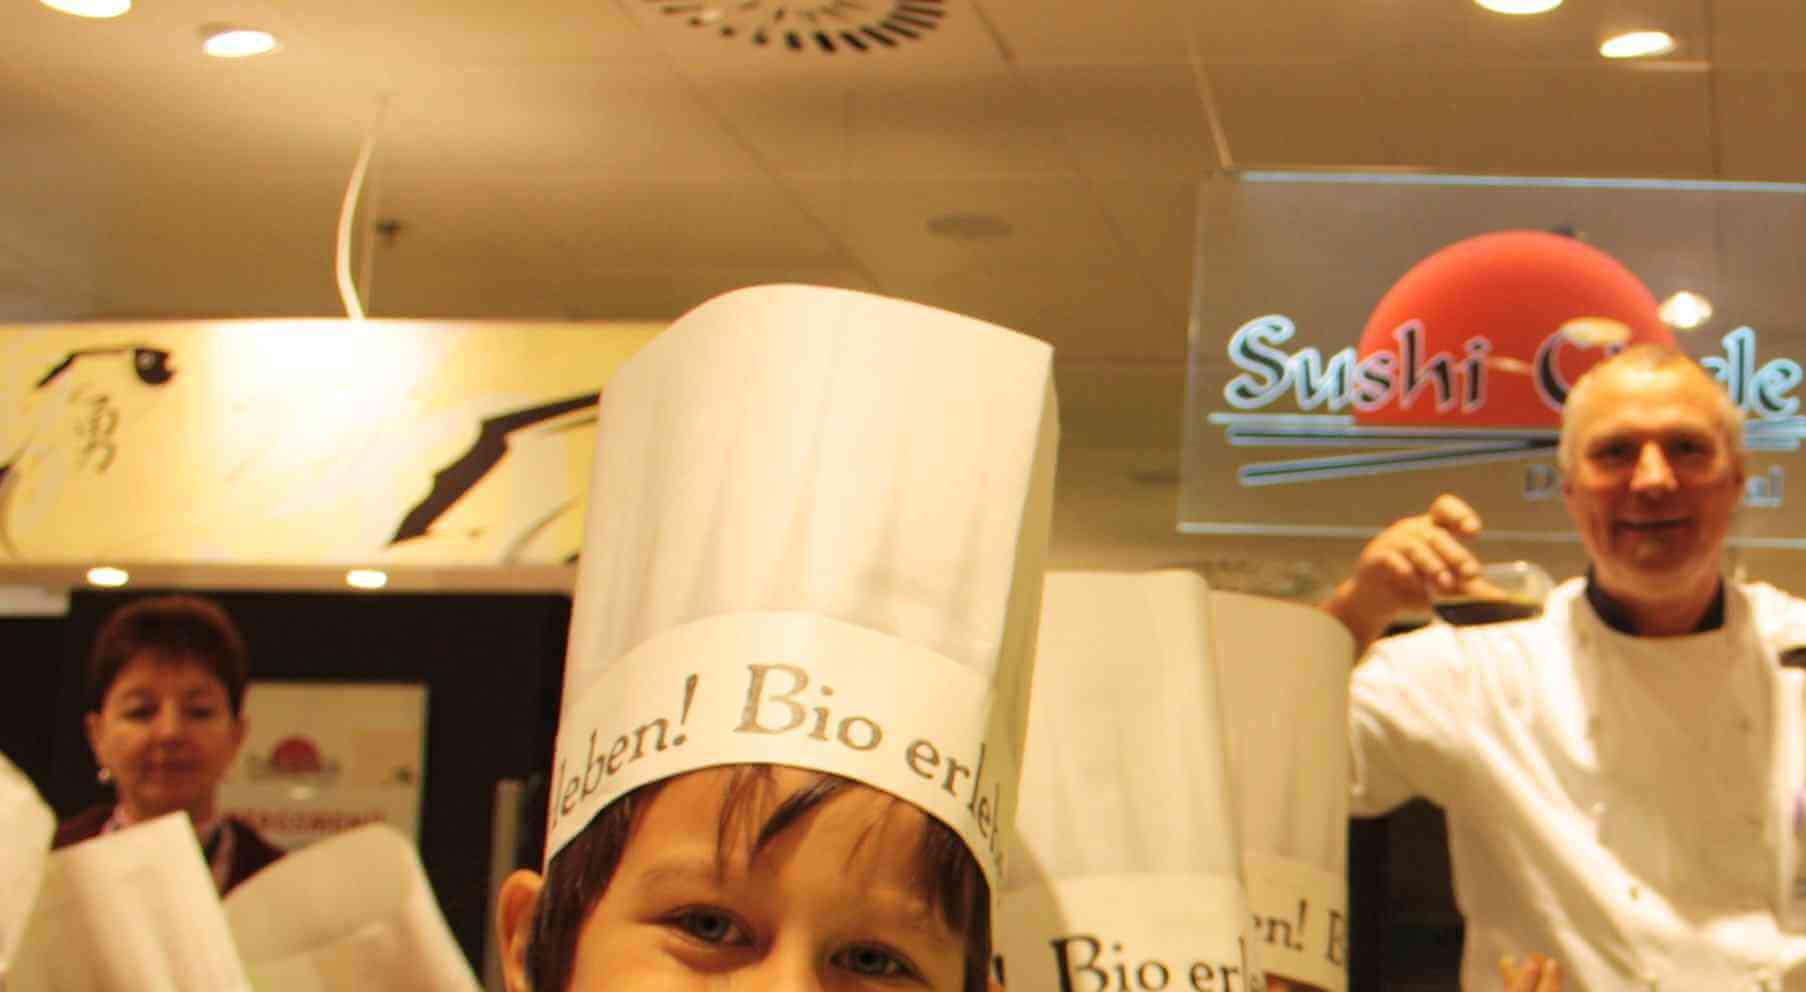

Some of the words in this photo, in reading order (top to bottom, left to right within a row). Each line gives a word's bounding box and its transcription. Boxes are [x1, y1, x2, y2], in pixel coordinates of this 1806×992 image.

[1224, 314, 1491, 413] Sushi
[1531, 318, 1805, 418] Cle
[733, 663, 884, 752] Bio
